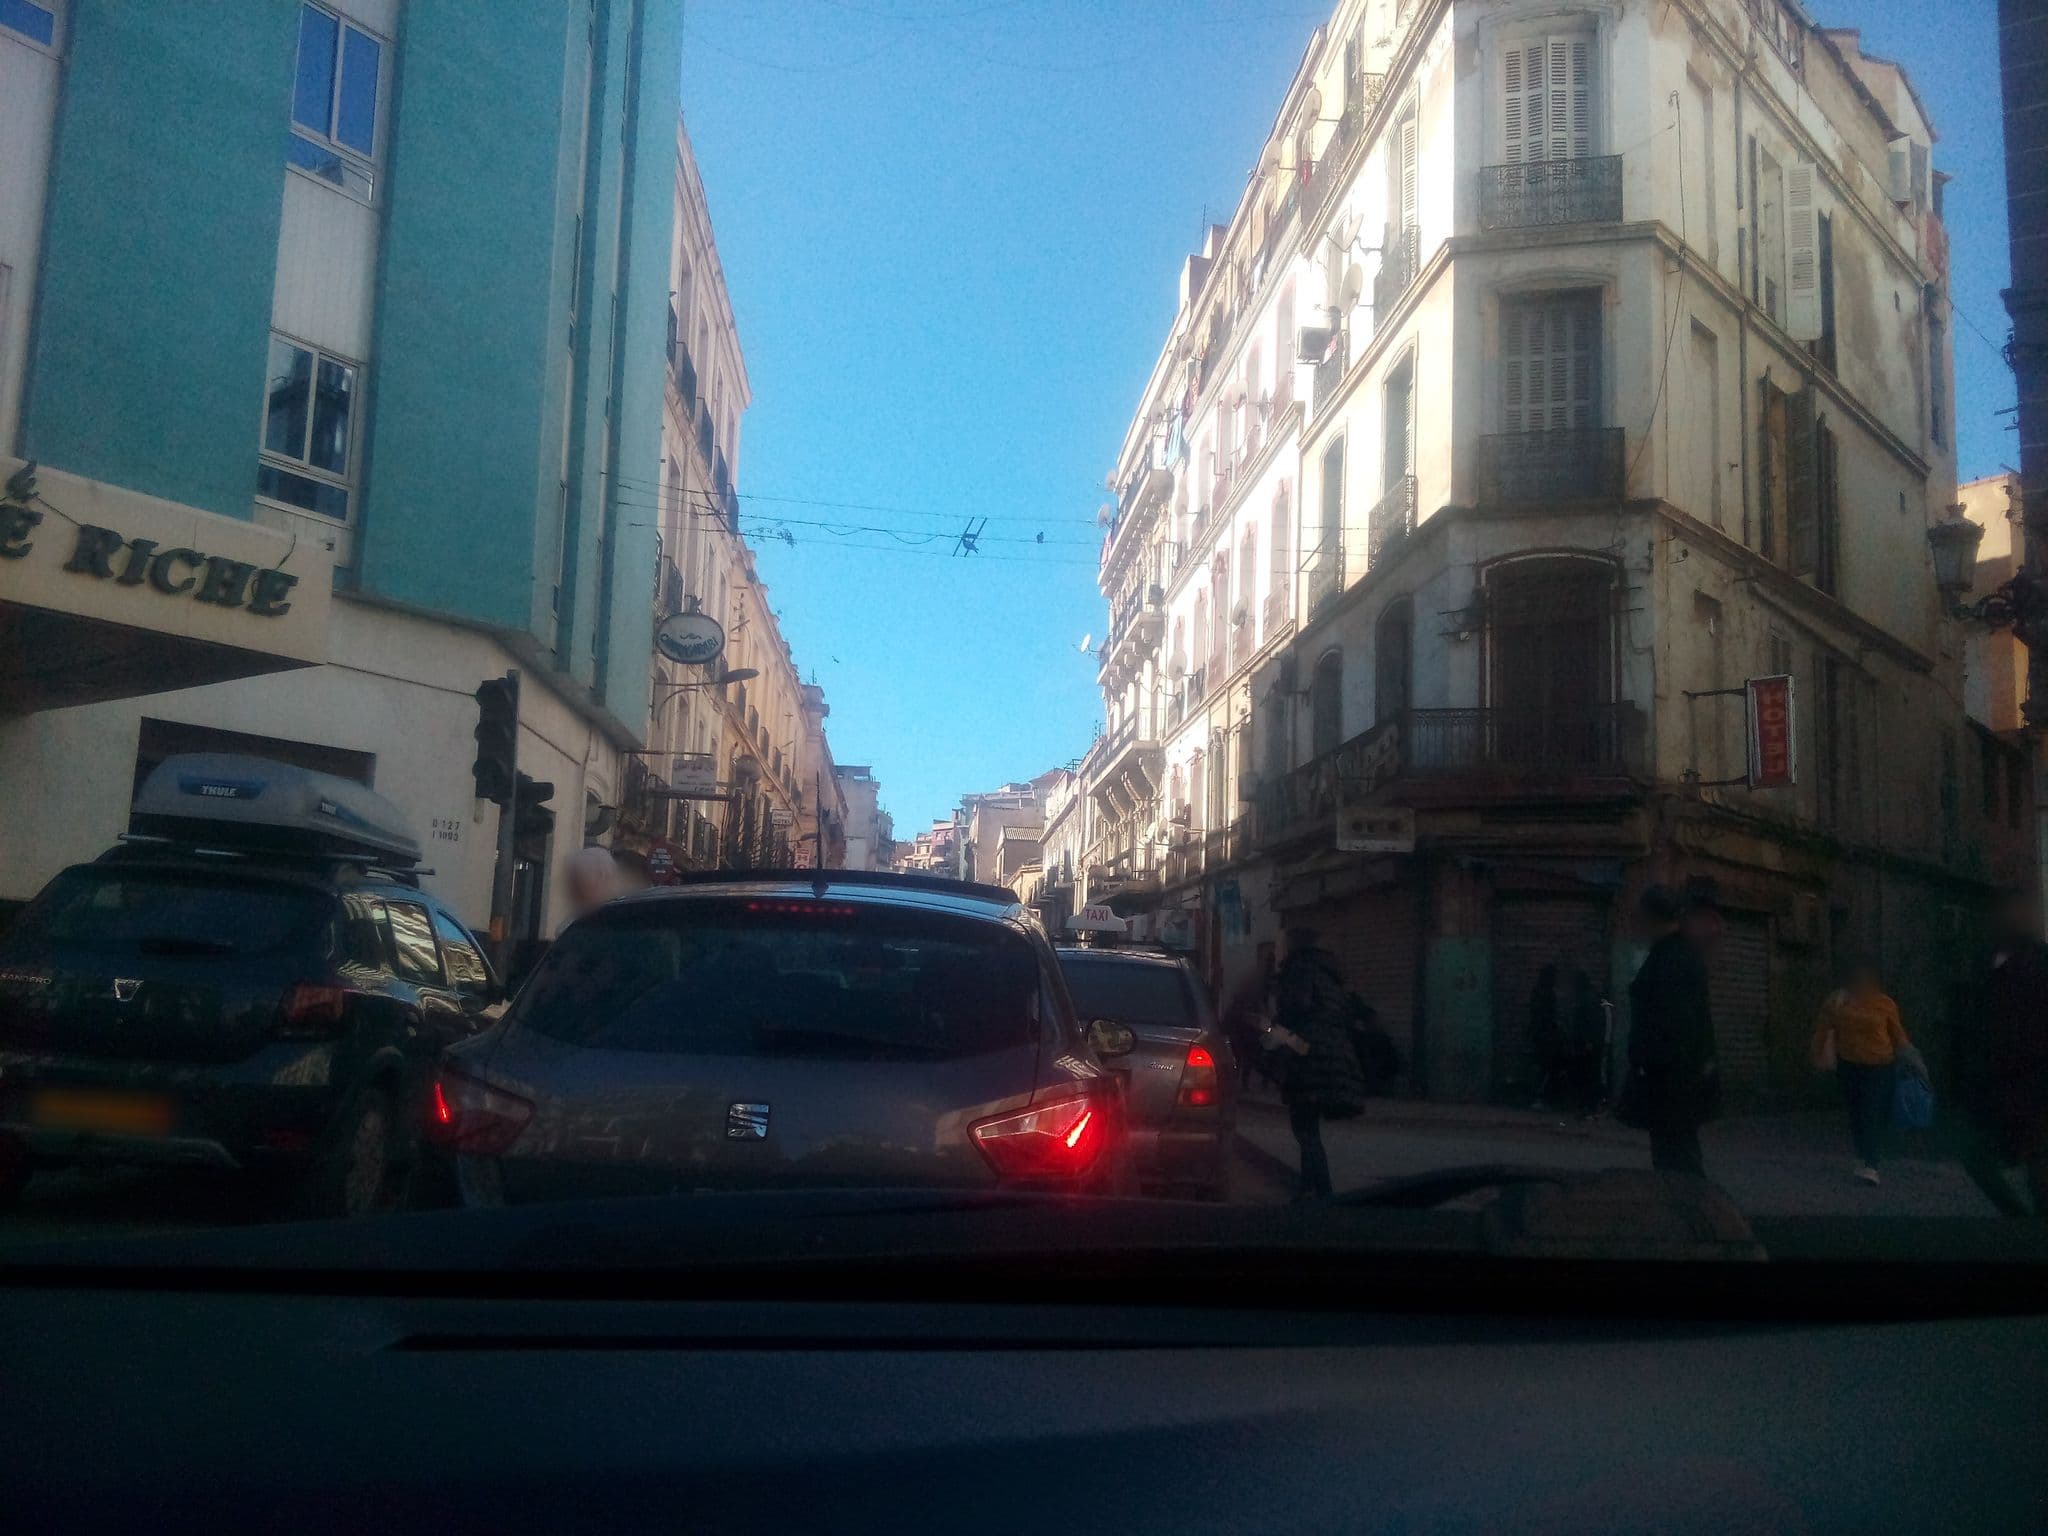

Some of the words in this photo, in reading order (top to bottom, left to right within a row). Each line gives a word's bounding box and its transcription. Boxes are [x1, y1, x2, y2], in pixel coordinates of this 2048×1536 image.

[64, 523, 299, 616] RICHE
[200, 784, 239, 798] THULE
[1085, 909, 1109, 922] TAXI
